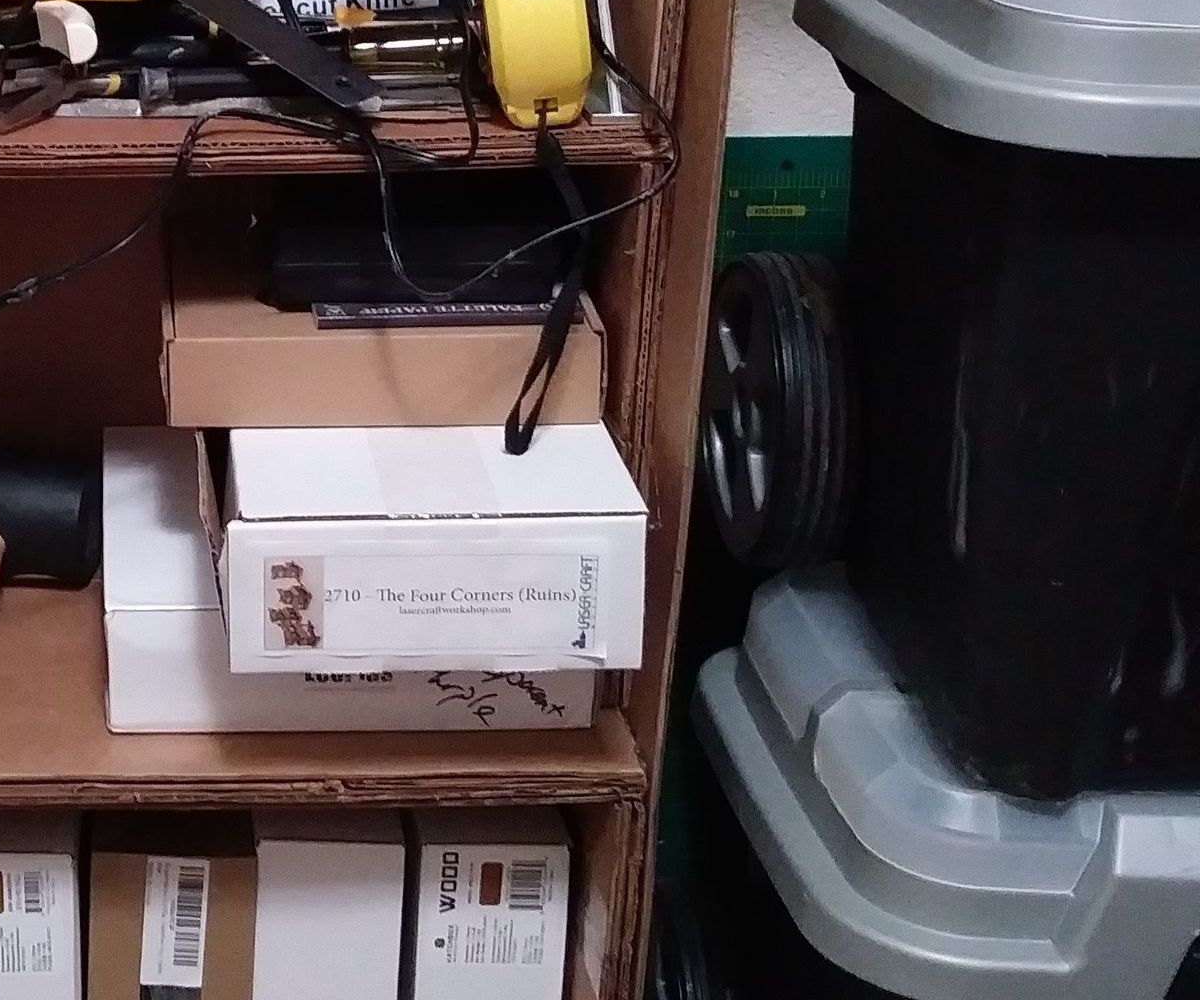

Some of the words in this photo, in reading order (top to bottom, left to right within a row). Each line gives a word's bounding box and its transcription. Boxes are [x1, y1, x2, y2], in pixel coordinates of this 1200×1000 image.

[324, 588, 361, 602] 2710
[375, 587, 408, 602] The
[410, 588, 445, 602] Four
[450, 587, 514, 602] Corners
[518, 587, 577, 603] (Ruins)
[438, 851, 460, 914] WOOD
